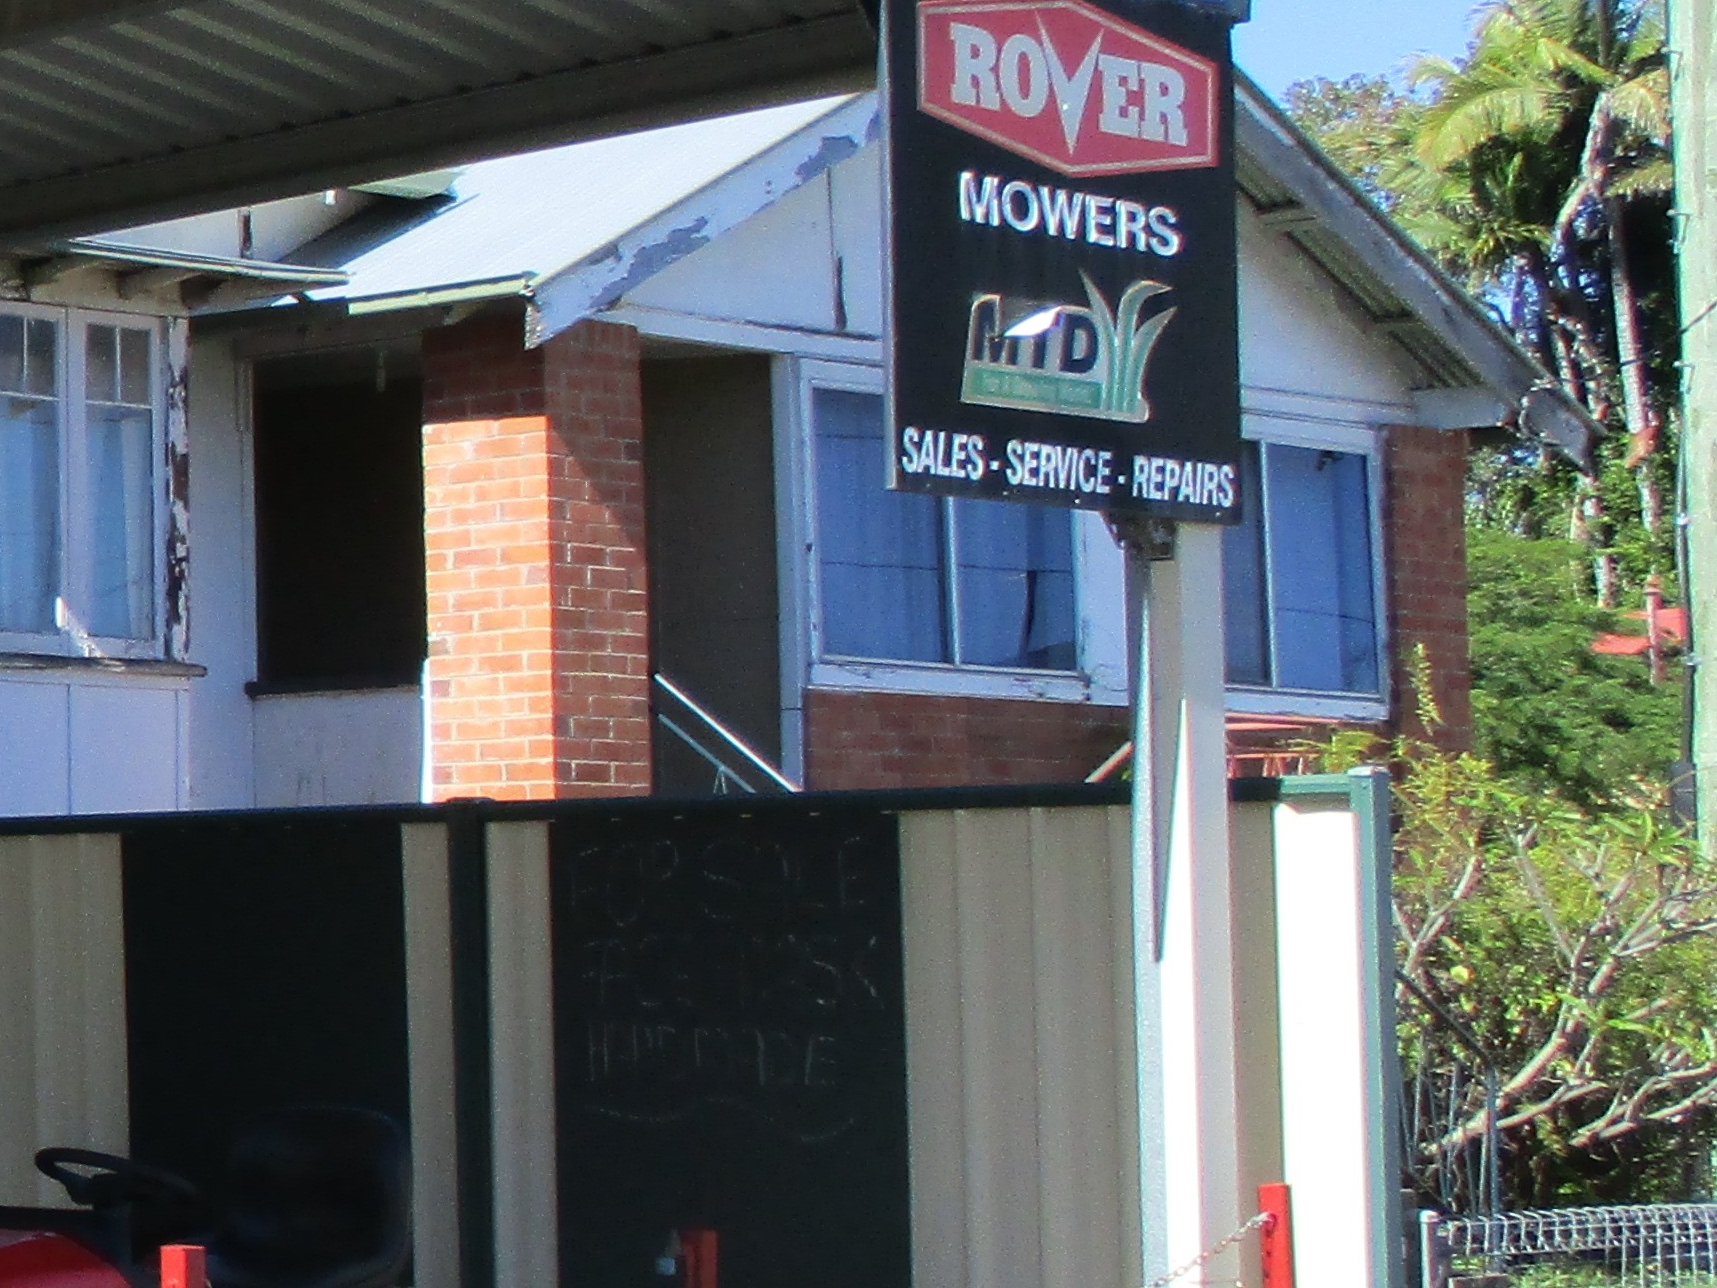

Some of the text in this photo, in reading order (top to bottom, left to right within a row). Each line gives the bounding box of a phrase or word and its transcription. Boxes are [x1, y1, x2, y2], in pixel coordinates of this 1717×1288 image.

[950, 14, 1187, 155] ROVER
[959, 171, 1182, 256] MOWERS
[902, 427, 986, 481] SALES
[1006, 439, 1112, 494] SERVICE
[1132, 455, 1235, 508] REPAIRS
